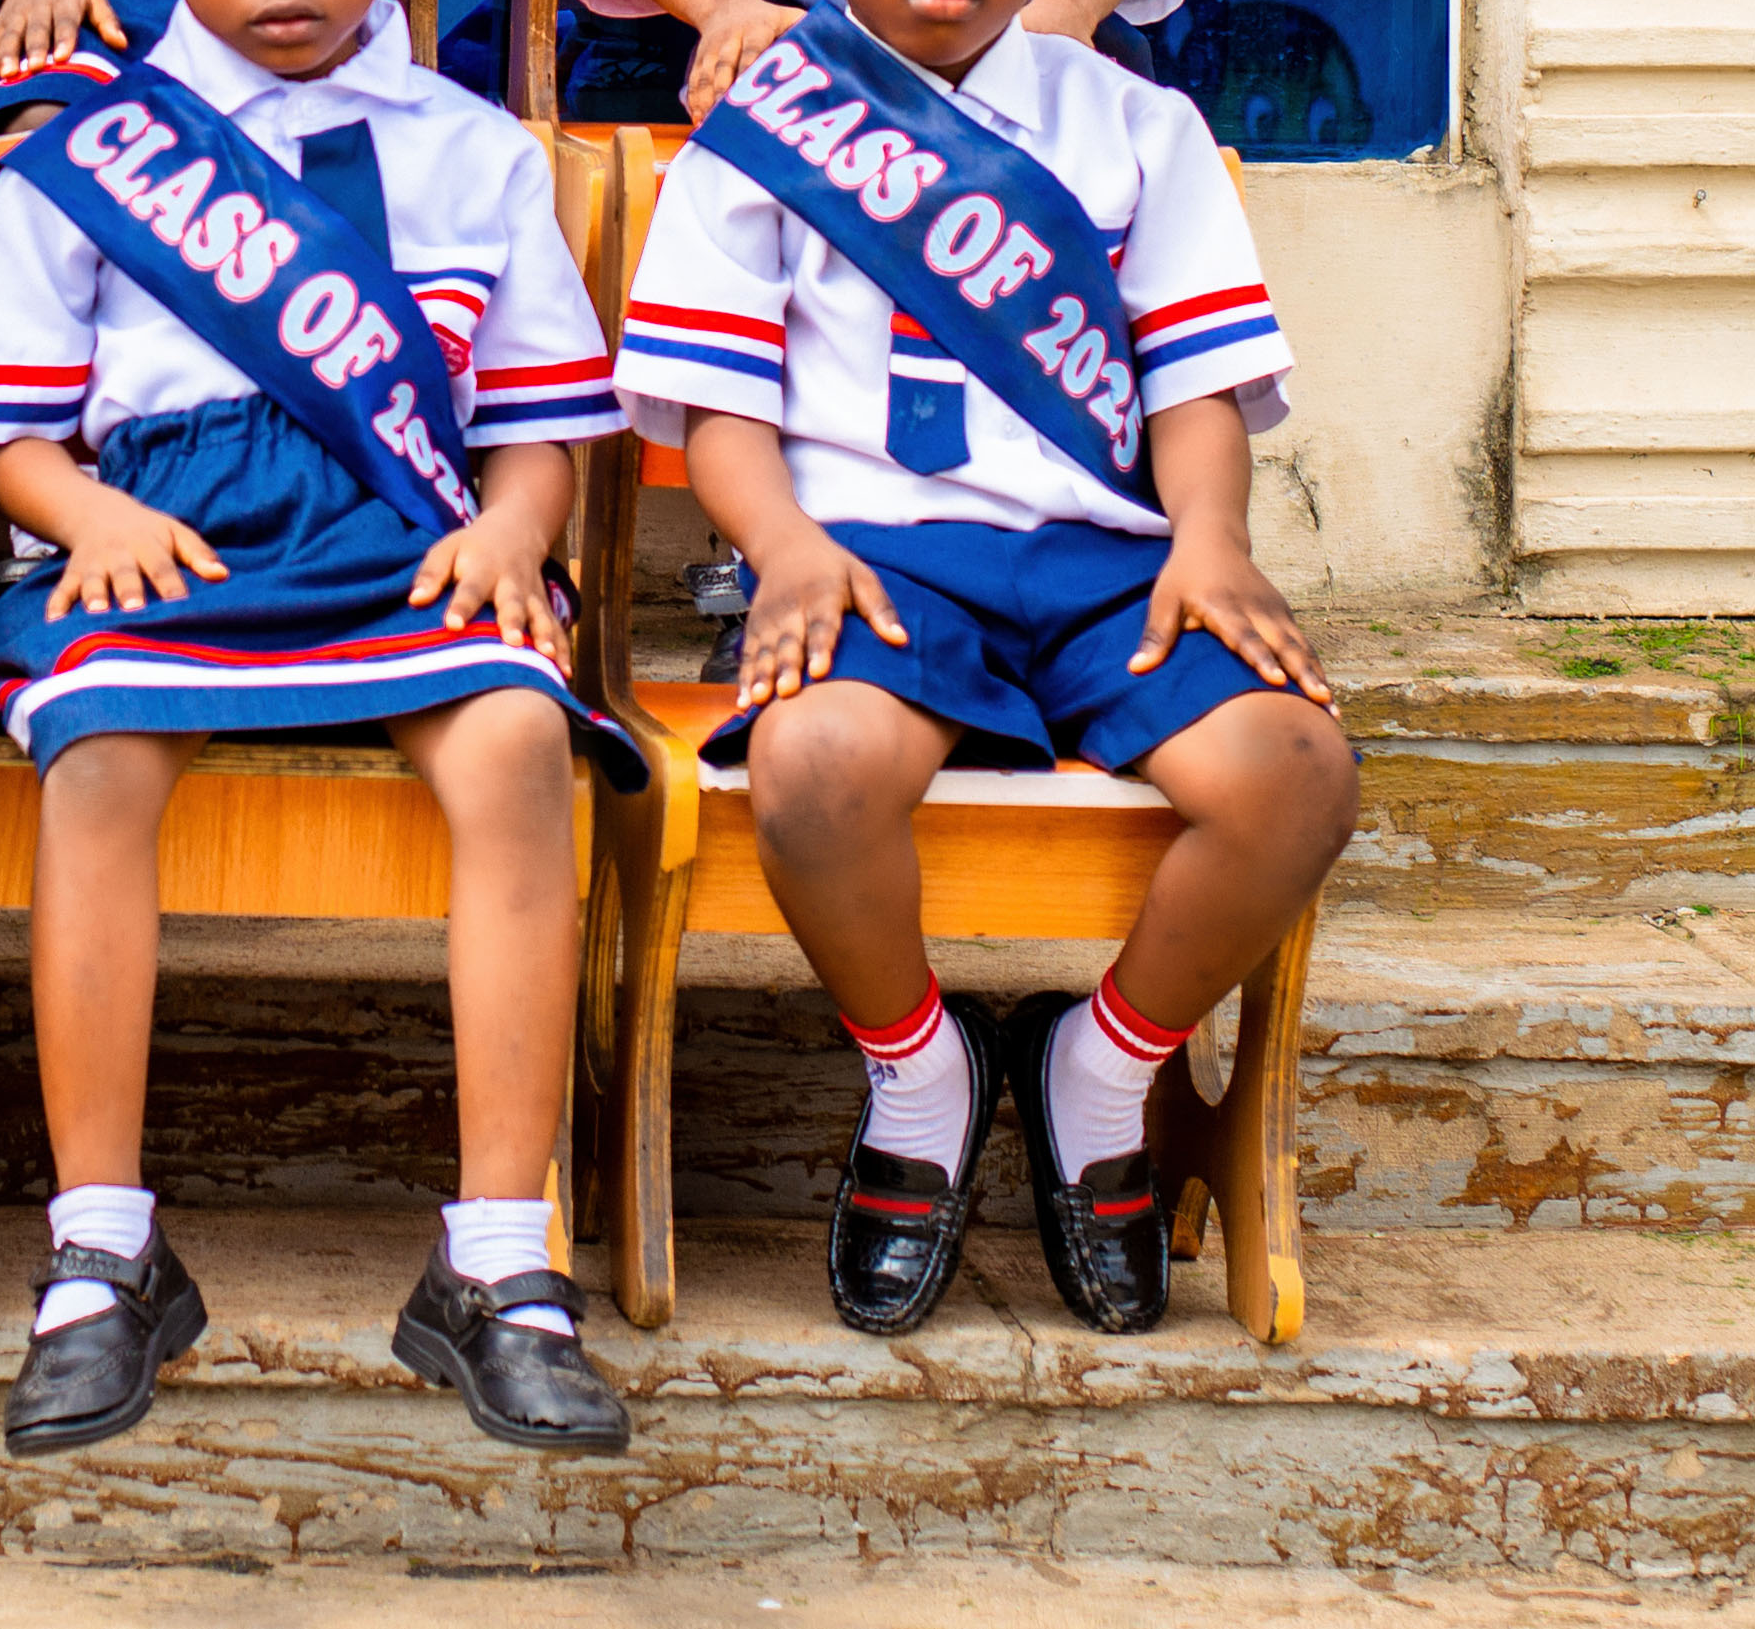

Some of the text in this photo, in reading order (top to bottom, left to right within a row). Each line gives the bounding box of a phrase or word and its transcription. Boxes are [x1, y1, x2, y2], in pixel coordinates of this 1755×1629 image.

[66, 101, 299, 302] CLASS
[278, 271, 402, 388] OF
[727, 40, 1143, 472] CLASS OF 2025
